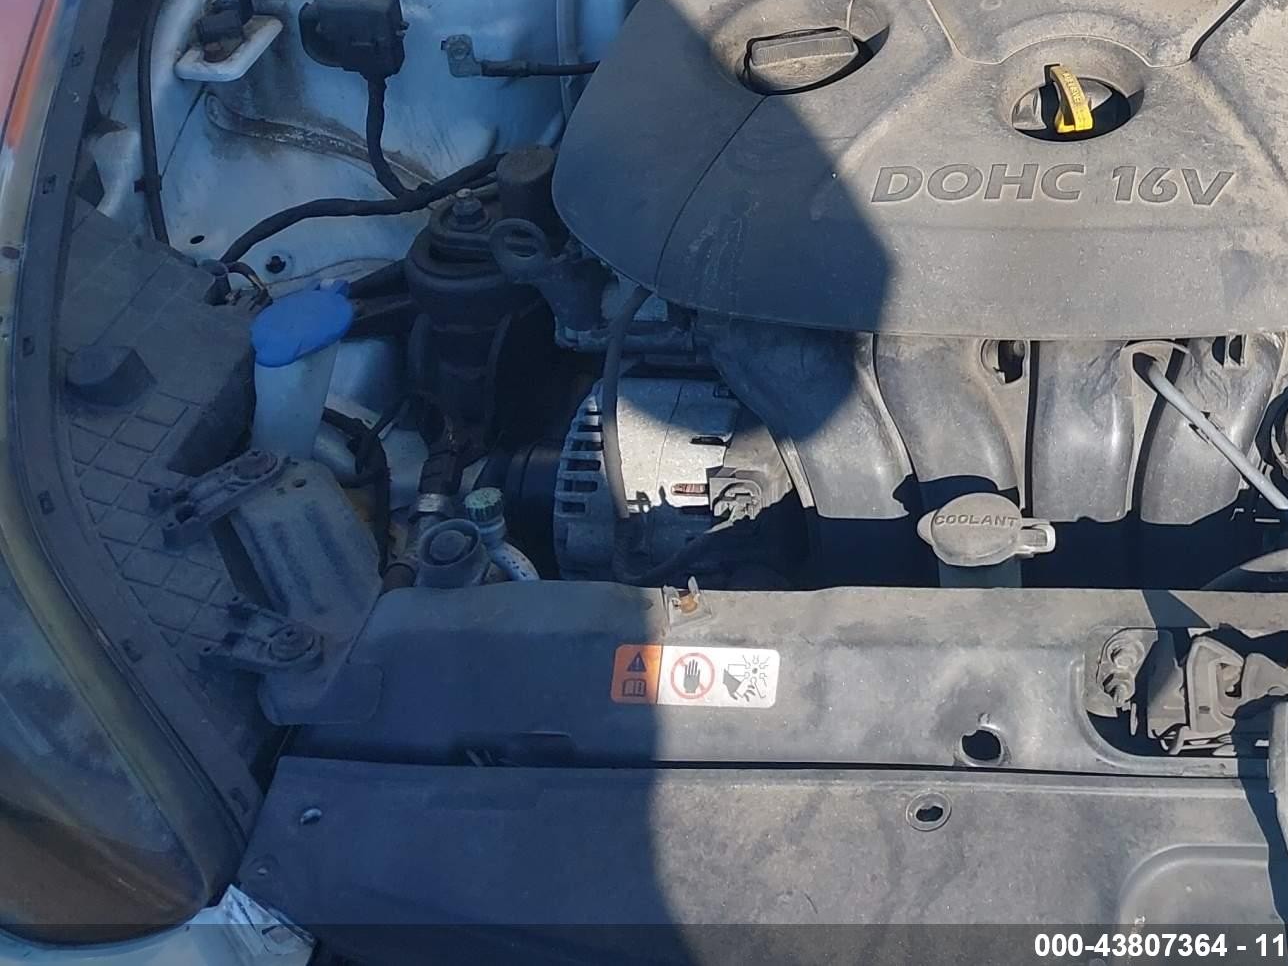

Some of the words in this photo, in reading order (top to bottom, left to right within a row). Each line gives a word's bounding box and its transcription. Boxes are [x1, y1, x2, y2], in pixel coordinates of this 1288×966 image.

[871, 163, 1085, 203] DOHC
[1113, 166, 1235, 206] 16V
[934, 514, 1018, 527] COOLANT
